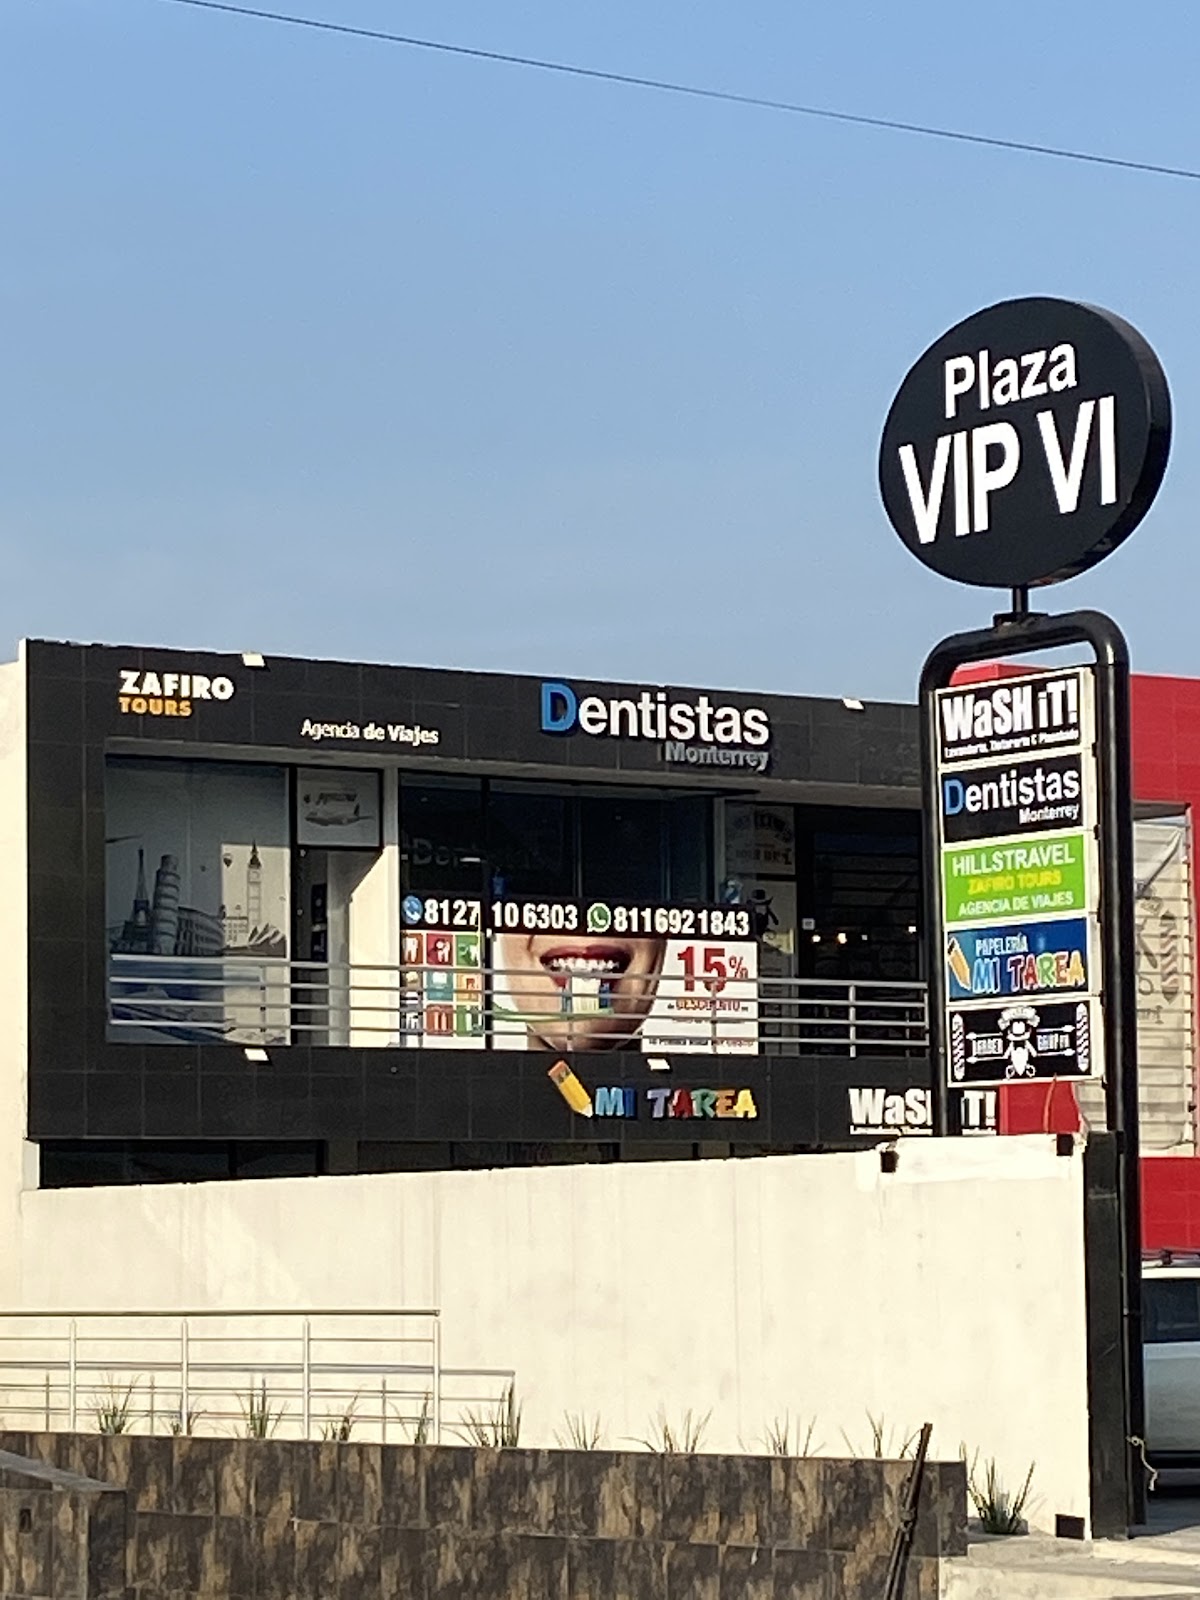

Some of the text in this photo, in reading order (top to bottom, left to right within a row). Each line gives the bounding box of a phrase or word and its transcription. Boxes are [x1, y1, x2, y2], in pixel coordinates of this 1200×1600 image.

[945, 341, 1077, 418] Plaza
[898, 396, 1117, 544] VIP VI
[119, 669, 234, 701] ZAFIRO
[119, 697, 193, 717] TOURS
[540, 682, 770, 746] Dentistas
[941, 678, 1079, 743] WaSH iT!
[300, 718, 439, 747] Agencia de Viajes
[664, 740, 769, 772] Monterrey
[944, 766, 1081, 816] Dentistas
[1018, 803, 1080, 825] Monterrey
[952, 842, 1076, 877] HILLSTRAVEL
[967, 868, 1063, 895] ZAFIRO TOURS
[958, 890, 1075, 917] AGENCIA DE VIAJES
[975, 932, 1029, 957] PAPELERÍA
[972, 949, 1086, 994] MI TAREA
[595, 1086, 758, 1119] MI TAREA
